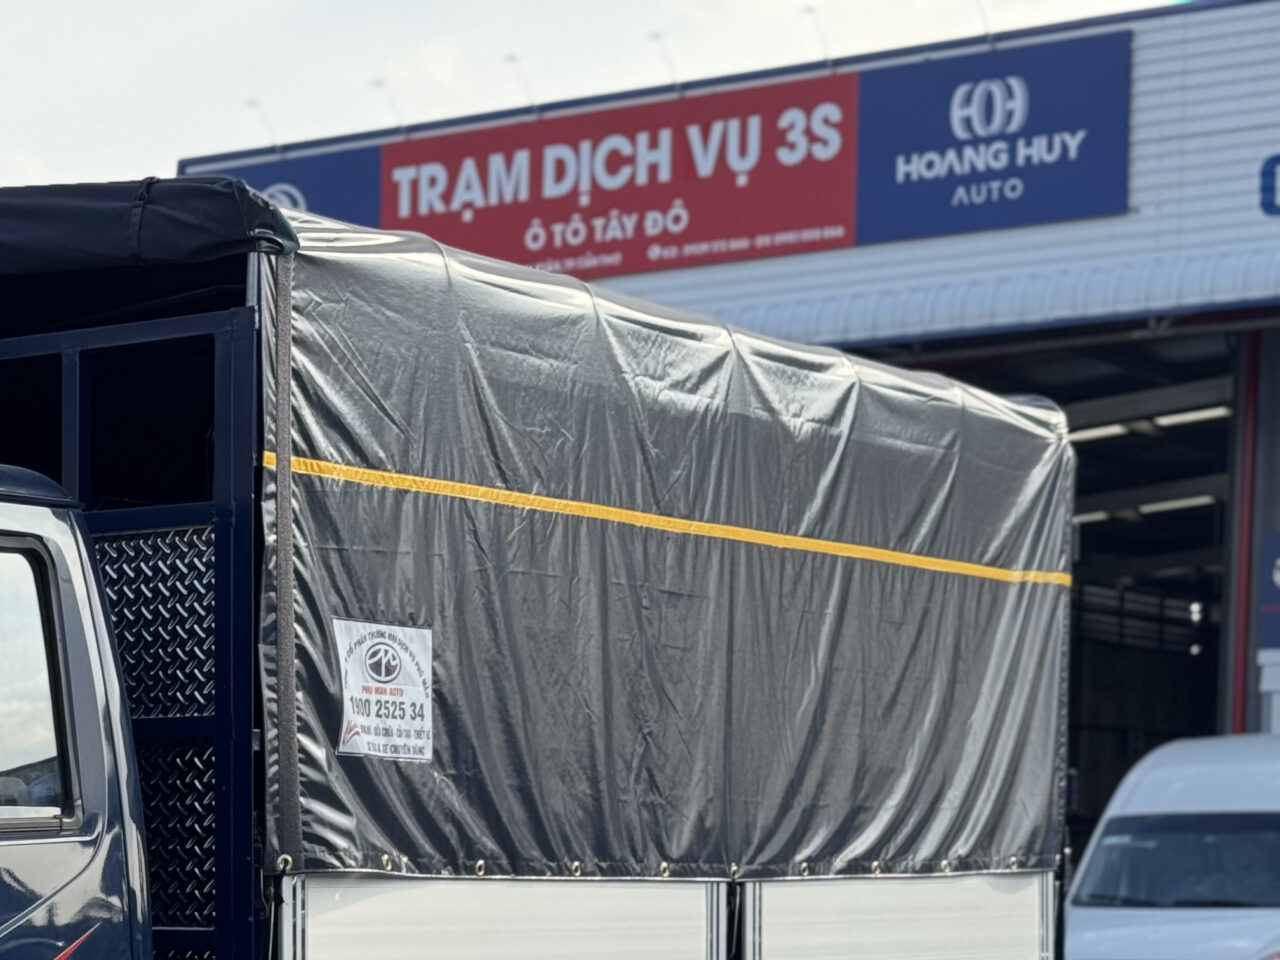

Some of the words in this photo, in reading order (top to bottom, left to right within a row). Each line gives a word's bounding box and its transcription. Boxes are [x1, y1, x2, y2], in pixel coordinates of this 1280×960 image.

[392, 148, 530, 223] TRẠM
[542, 128, 672, 206] DỊCH
[686, 114, 762, 187] VỤ
[775, 102, 843, 166] 3S
[1016, 129, 1088, 167] HUY
[951, 177, 1024, 207] AUTO
[524, 217, 547, 250] Ô
[552, 213, 587, 248] TÔ
[592, 208, 638, 242] TÂY
[644, 198, 689, 237] ĐÔ
[349, 695, 371, 718] 1900
[375, 699, 406, 720] 2525
[410, 702, 425, 721] 34
